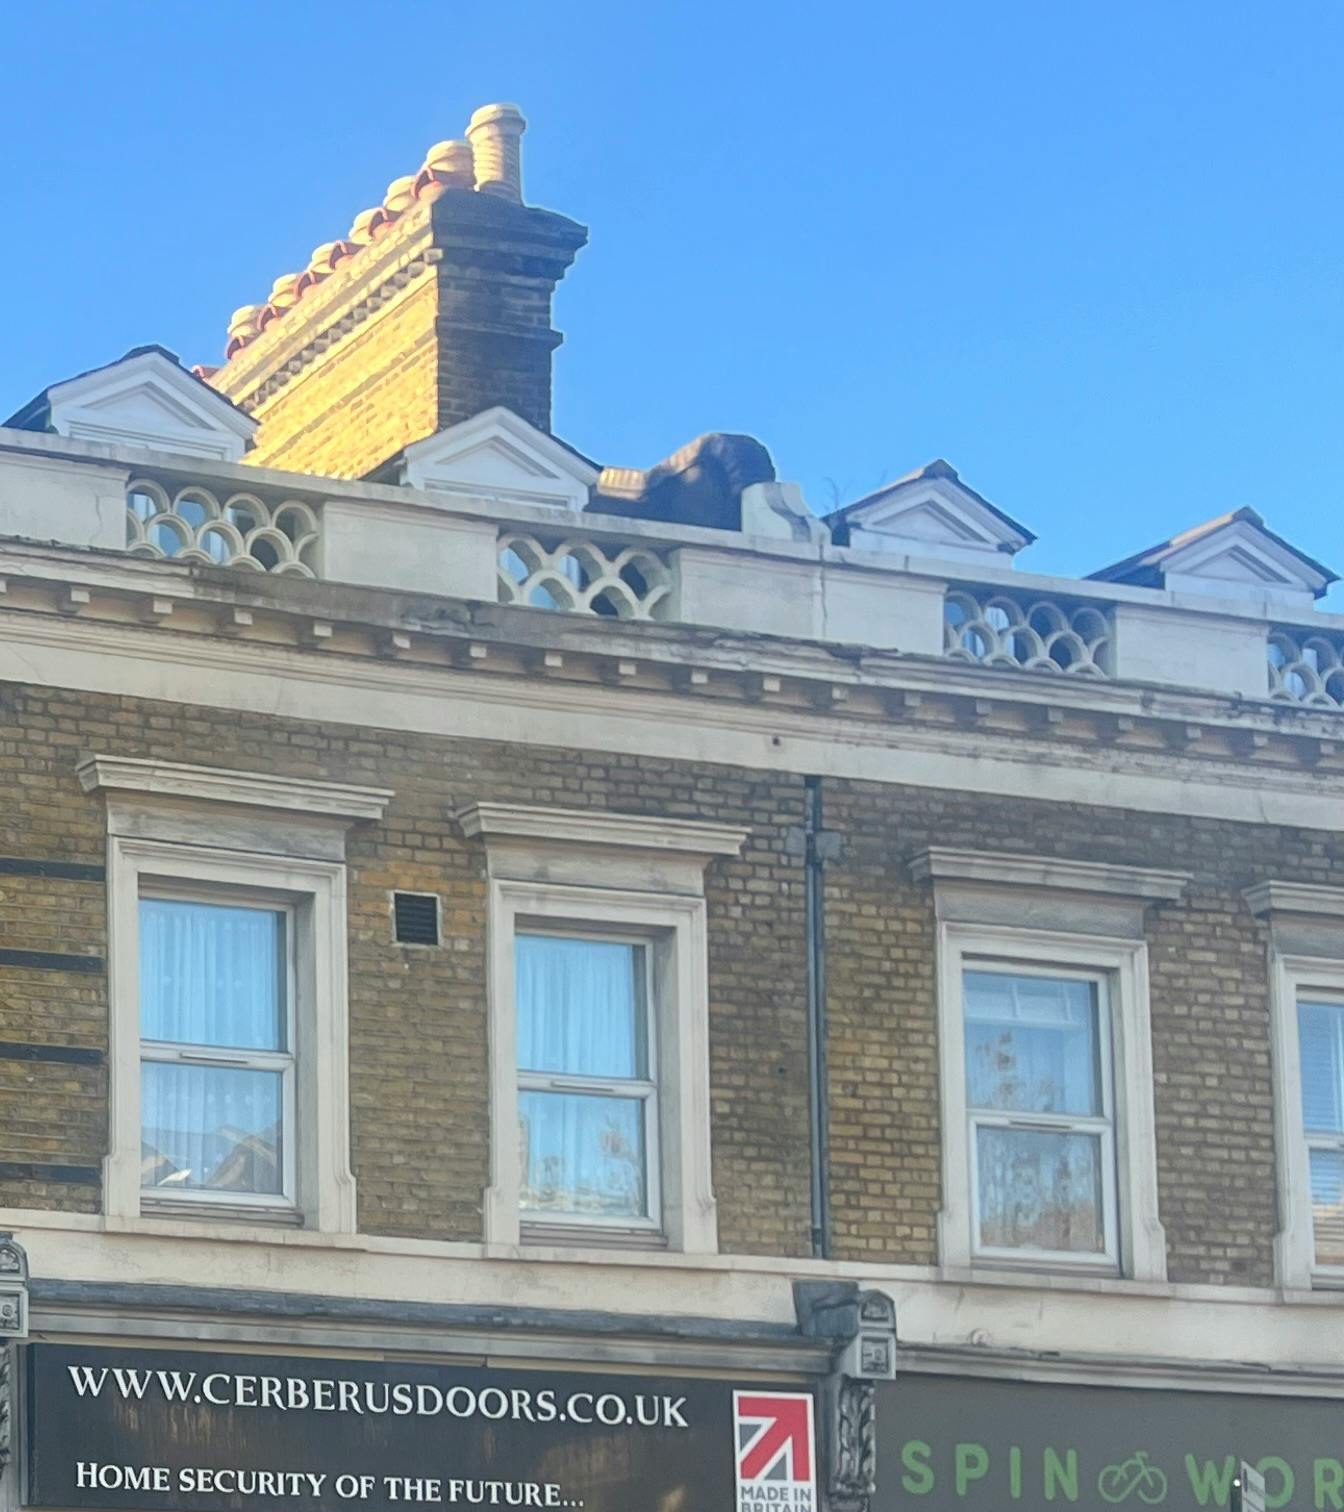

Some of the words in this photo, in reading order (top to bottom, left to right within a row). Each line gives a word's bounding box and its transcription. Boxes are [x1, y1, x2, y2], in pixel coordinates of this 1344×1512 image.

[67, 1365, 689, 1428] WWW.CERBERUSDOORS.CO.UK
[75, 1461, 171, 1493] HOME
[177, 1467, 327, 1498] SECURITY
[335, 1473, 378, 1499] OF
[384, 1475, 442, 1504] THE
[448, 1479, 585, 1509] FUTURE...
[740, 1486, 789, 1501] MADE
[793, 1487, 812, 1502] IN
[900, 1439, 1079, 1502] SPIN
